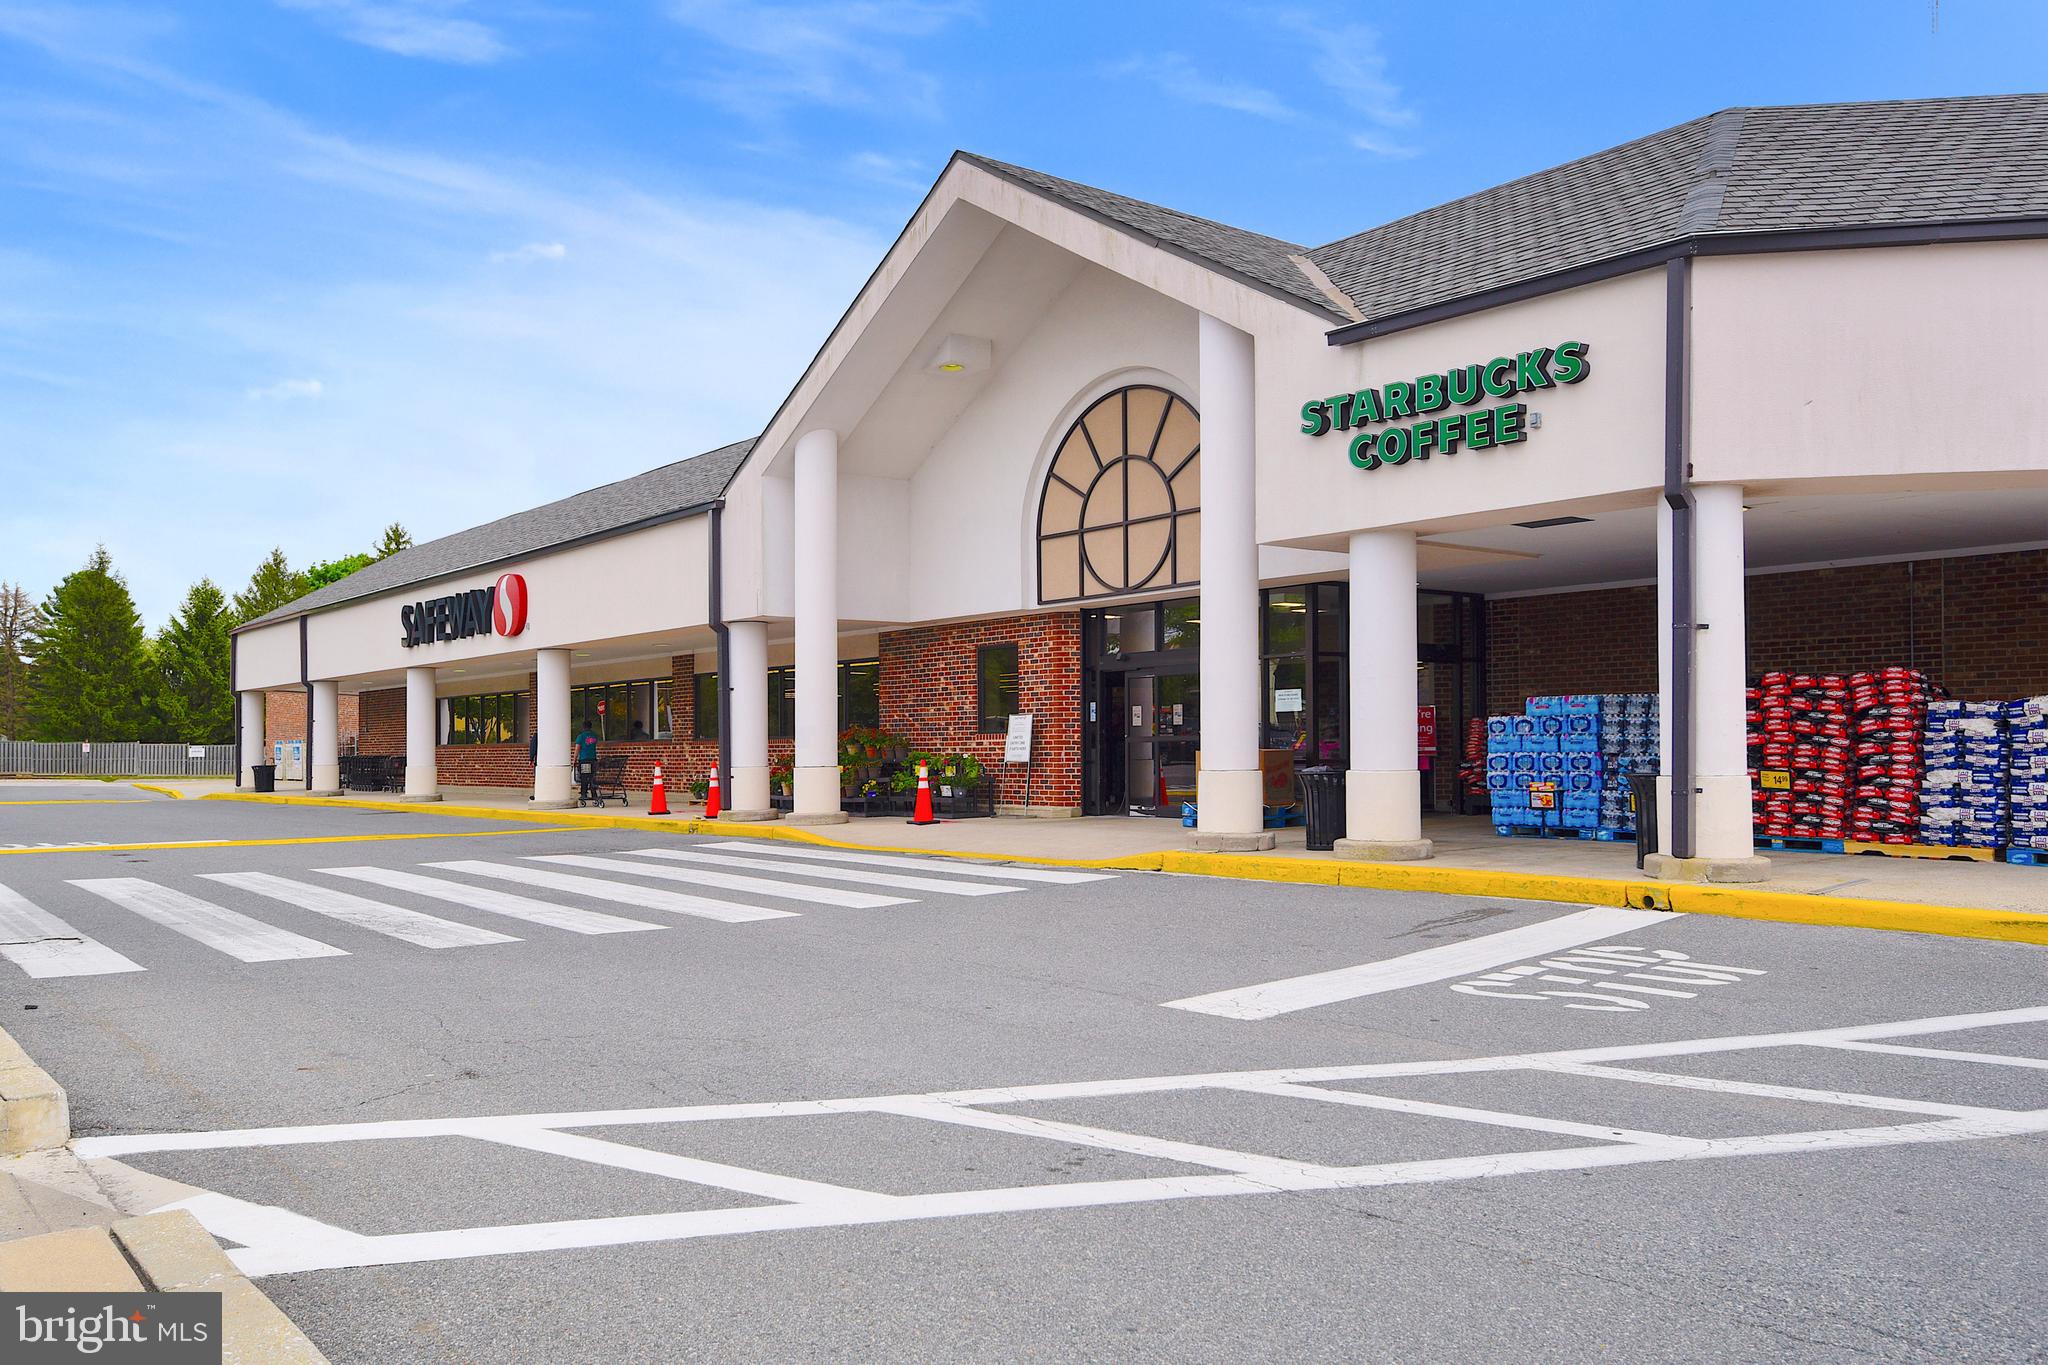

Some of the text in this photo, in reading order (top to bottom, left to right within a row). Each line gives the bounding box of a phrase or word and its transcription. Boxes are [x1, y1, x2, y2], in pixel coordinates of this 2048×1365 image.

[1300, 341, 1590, 436] STARBUCKS
[1348, 403, 1528, 470] COFFEE
[401, 586, 496, 647] SAFEWAY
[1450, 945, 1768, 1012] STOP
